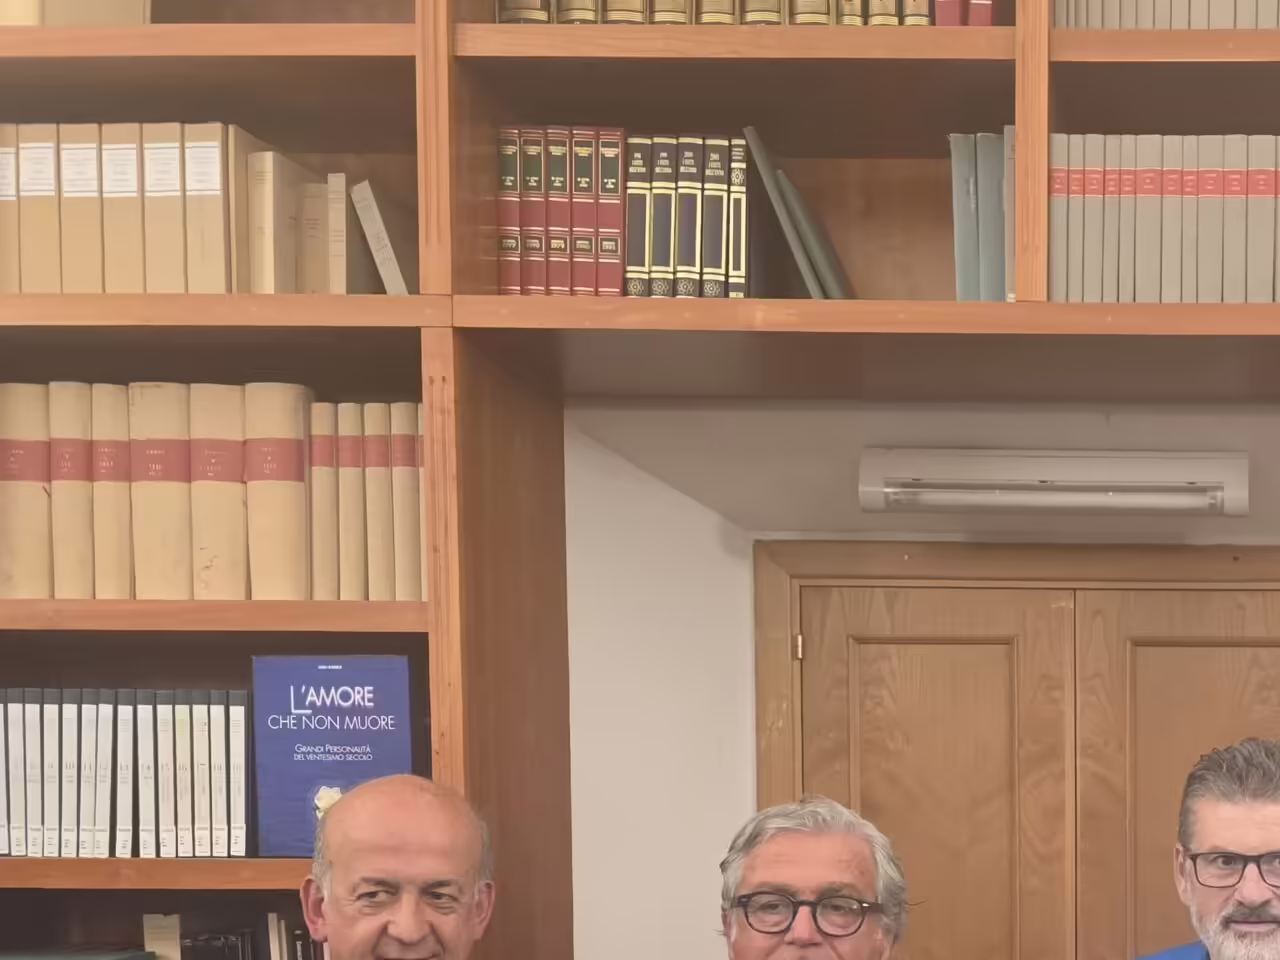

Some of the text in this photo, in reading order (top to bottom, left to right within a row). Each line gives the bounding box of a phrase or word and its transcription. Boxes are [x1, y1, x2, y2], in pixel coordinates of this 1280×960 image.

[290, 684, 374, 714] L'AMORE
[268, 715, 396, 729] CHE NON MUORE
